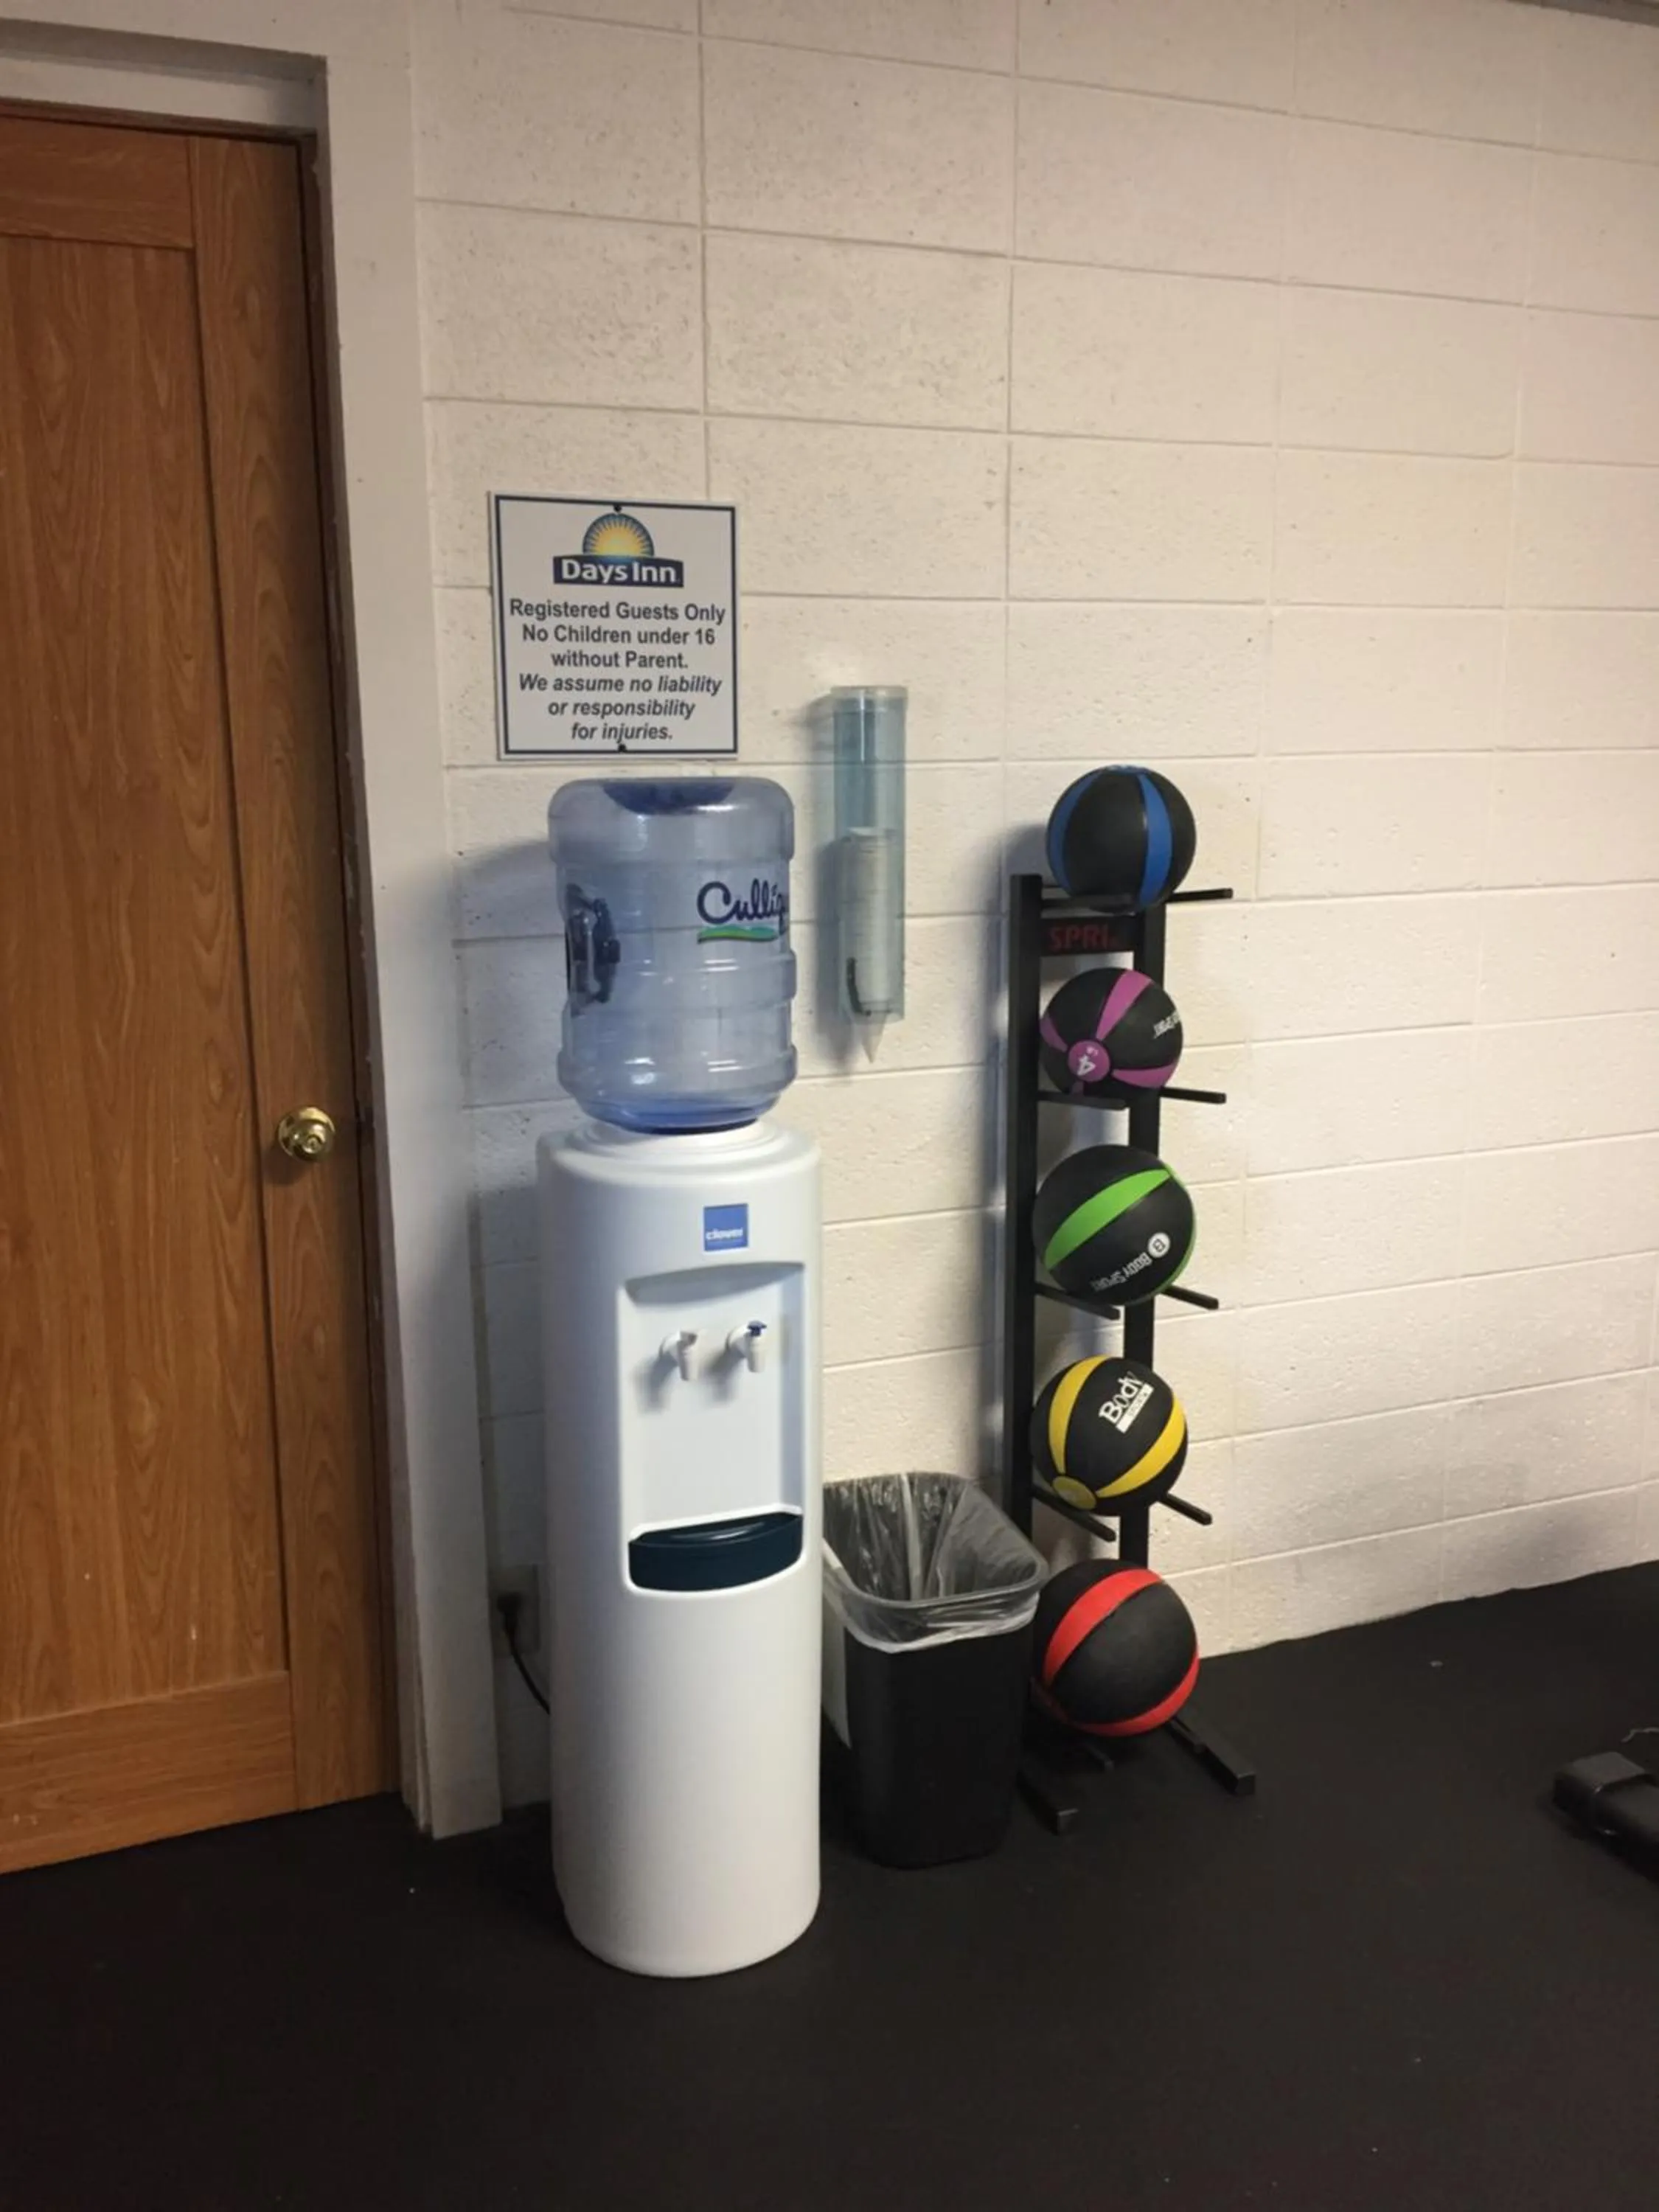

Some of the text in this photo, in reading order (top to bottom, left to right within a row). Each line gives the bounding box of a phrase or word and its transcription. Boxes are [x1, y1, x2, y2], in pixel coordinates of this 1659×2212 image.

[561, 559, 676, 584] Days Inn
[509, 599, 726, 625] Registered Guests Only
[522, 625, 715, 645] No Children under 16
[551, 650, 689, 669] without Parent.
[519, 672, 723, 697] We assume no liability
[547, 699, 696, 720] or responsibility
[571, 722, 672, 744] for injuries.
[1048, 923, 1110, 953] SPRI
[1077, 1054, 1096, 1076] 4
[1098, 1370, 1144, 1424] Body
